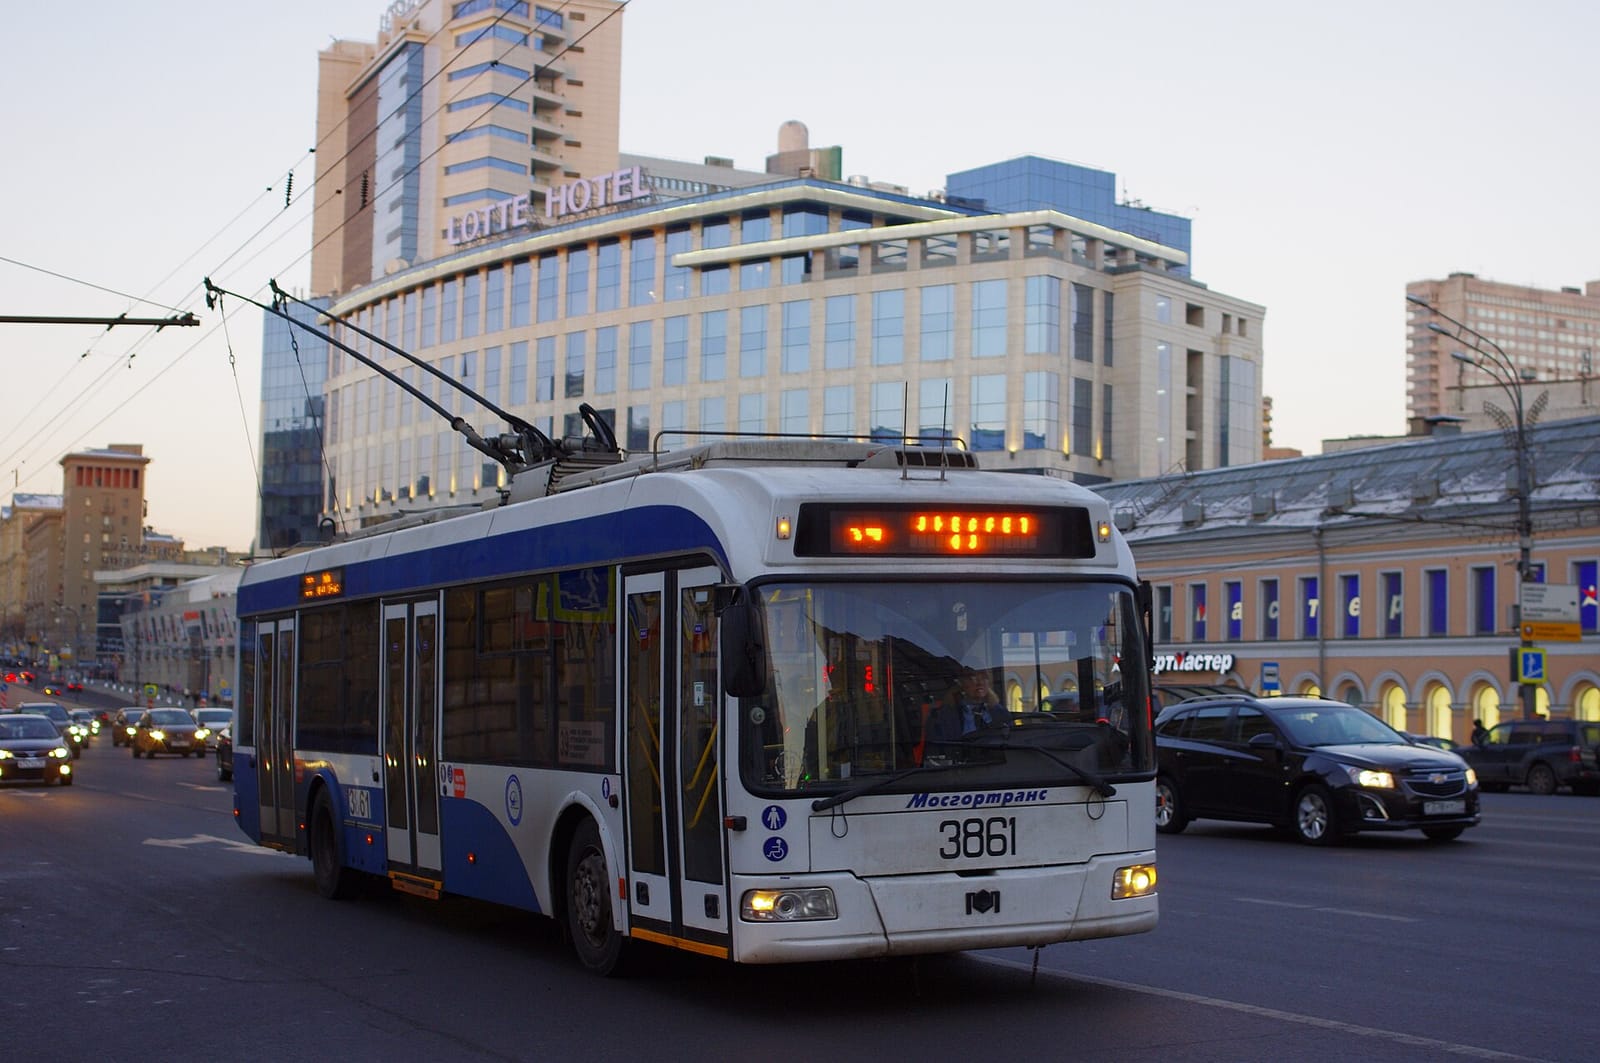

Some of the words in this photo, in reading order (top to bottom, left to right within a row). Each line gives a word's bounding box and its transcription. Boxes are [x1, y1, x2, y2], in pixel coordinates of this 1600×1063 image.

[446, 193, 529, 245] LOTTE
[545, 165, 650, 218] HOTEL
[348, 788, 369, 818] 361
[906, 789, 1048, 809] Мосгортранс
[939, 817, 1016, 859] 3861
